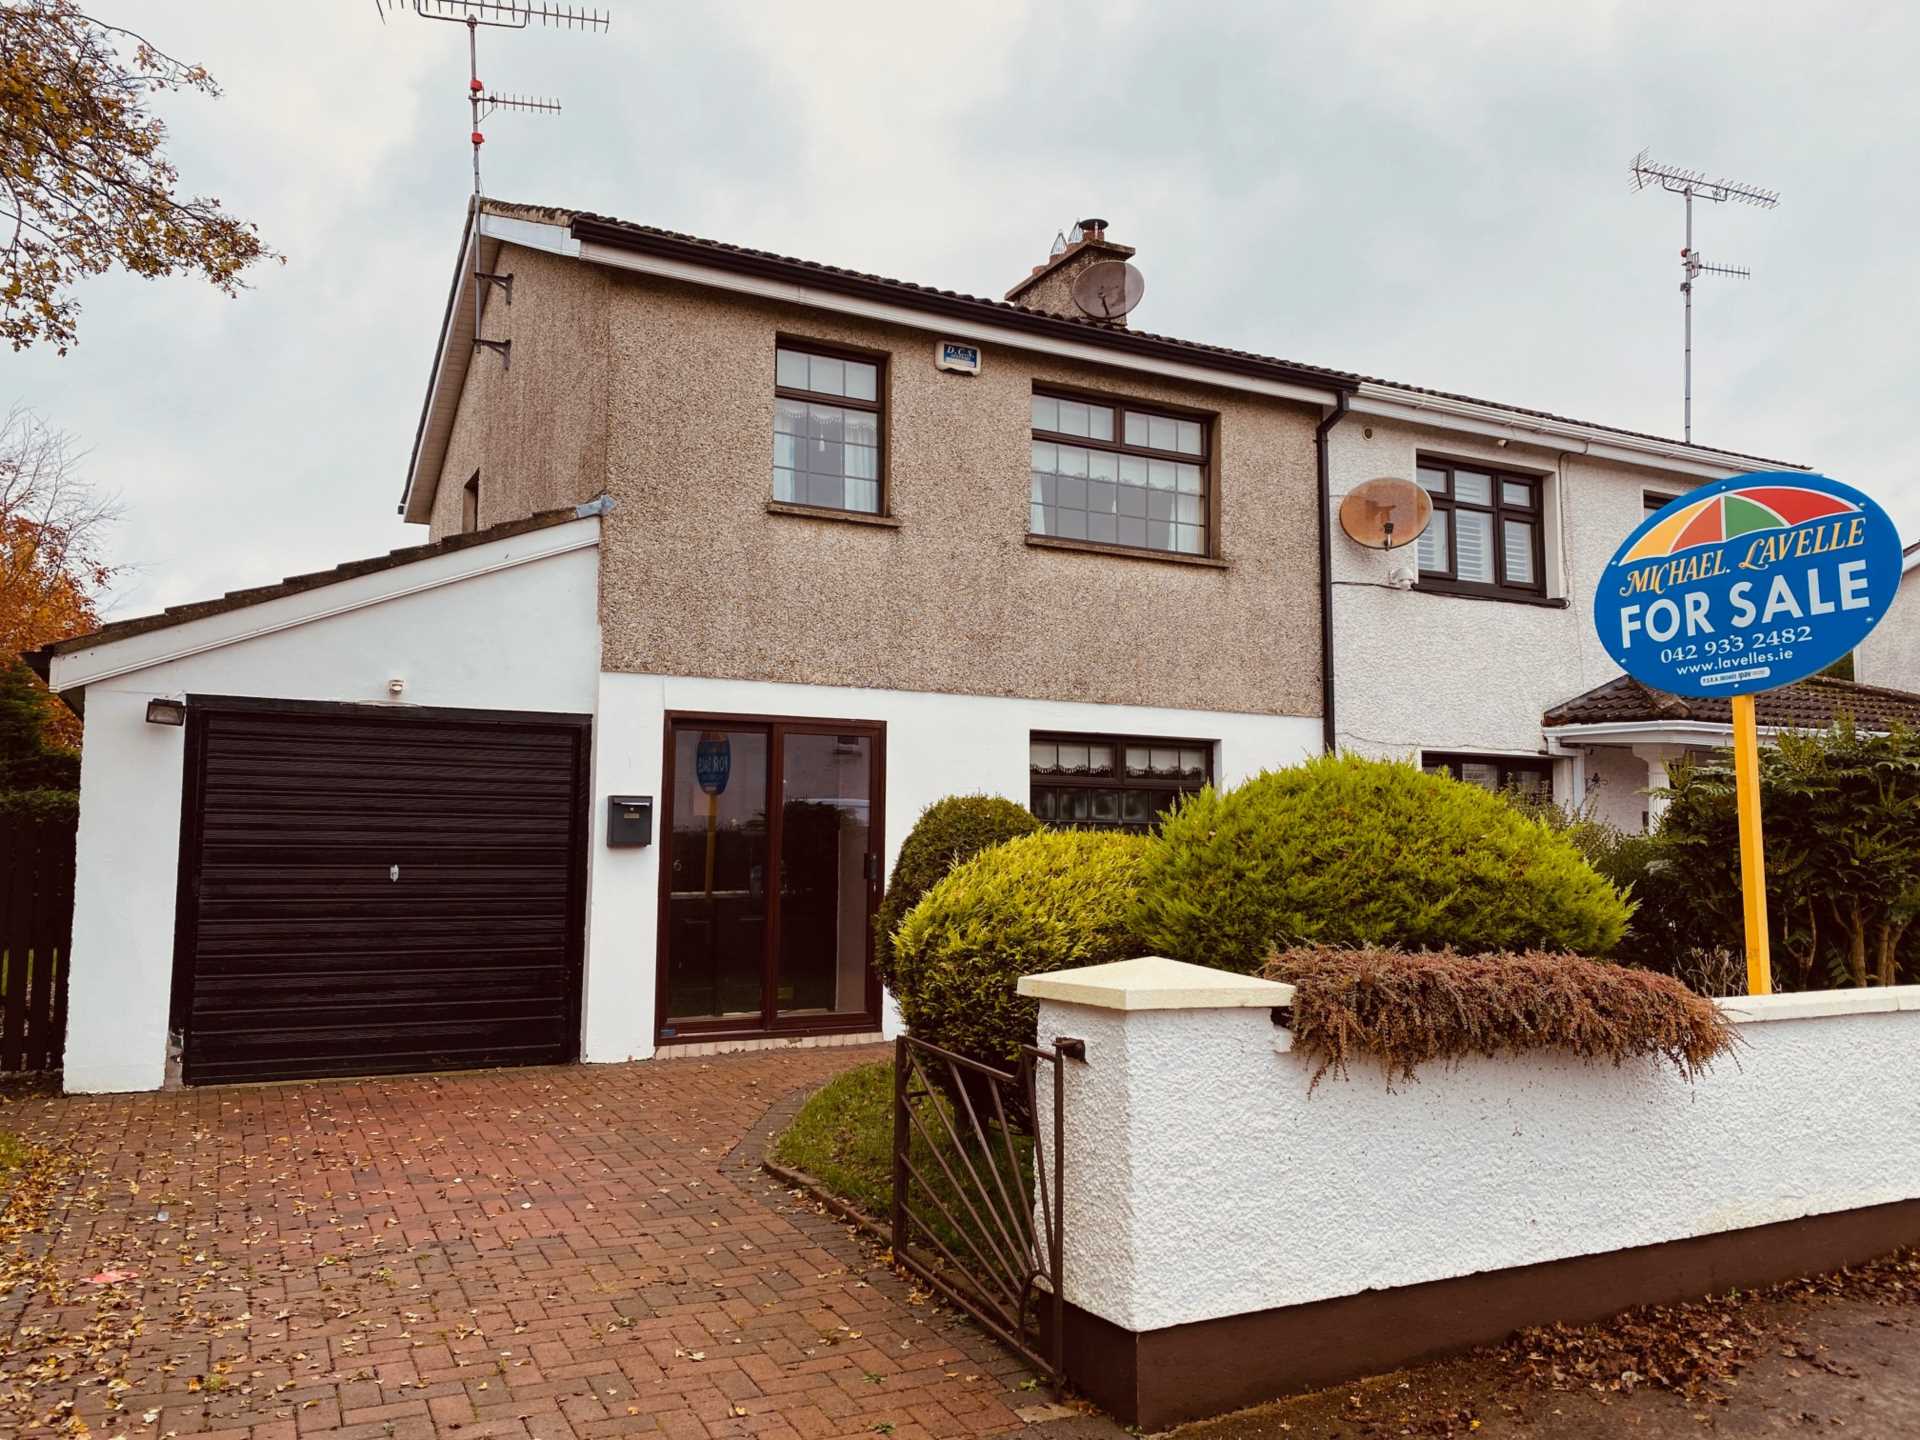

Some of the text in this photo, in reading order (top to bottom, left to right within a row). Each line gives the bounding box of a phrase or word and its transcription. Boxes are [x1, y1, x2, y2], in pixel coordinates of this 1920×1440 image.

[1738, 517, 1867, 571] LAVELLE
[1620, 559, 1870, 649] FOR SALE
[1660, 626, 1813, 664] 042 933 2482
[1676, 648, 1793, 675] www.lavelles.ie
